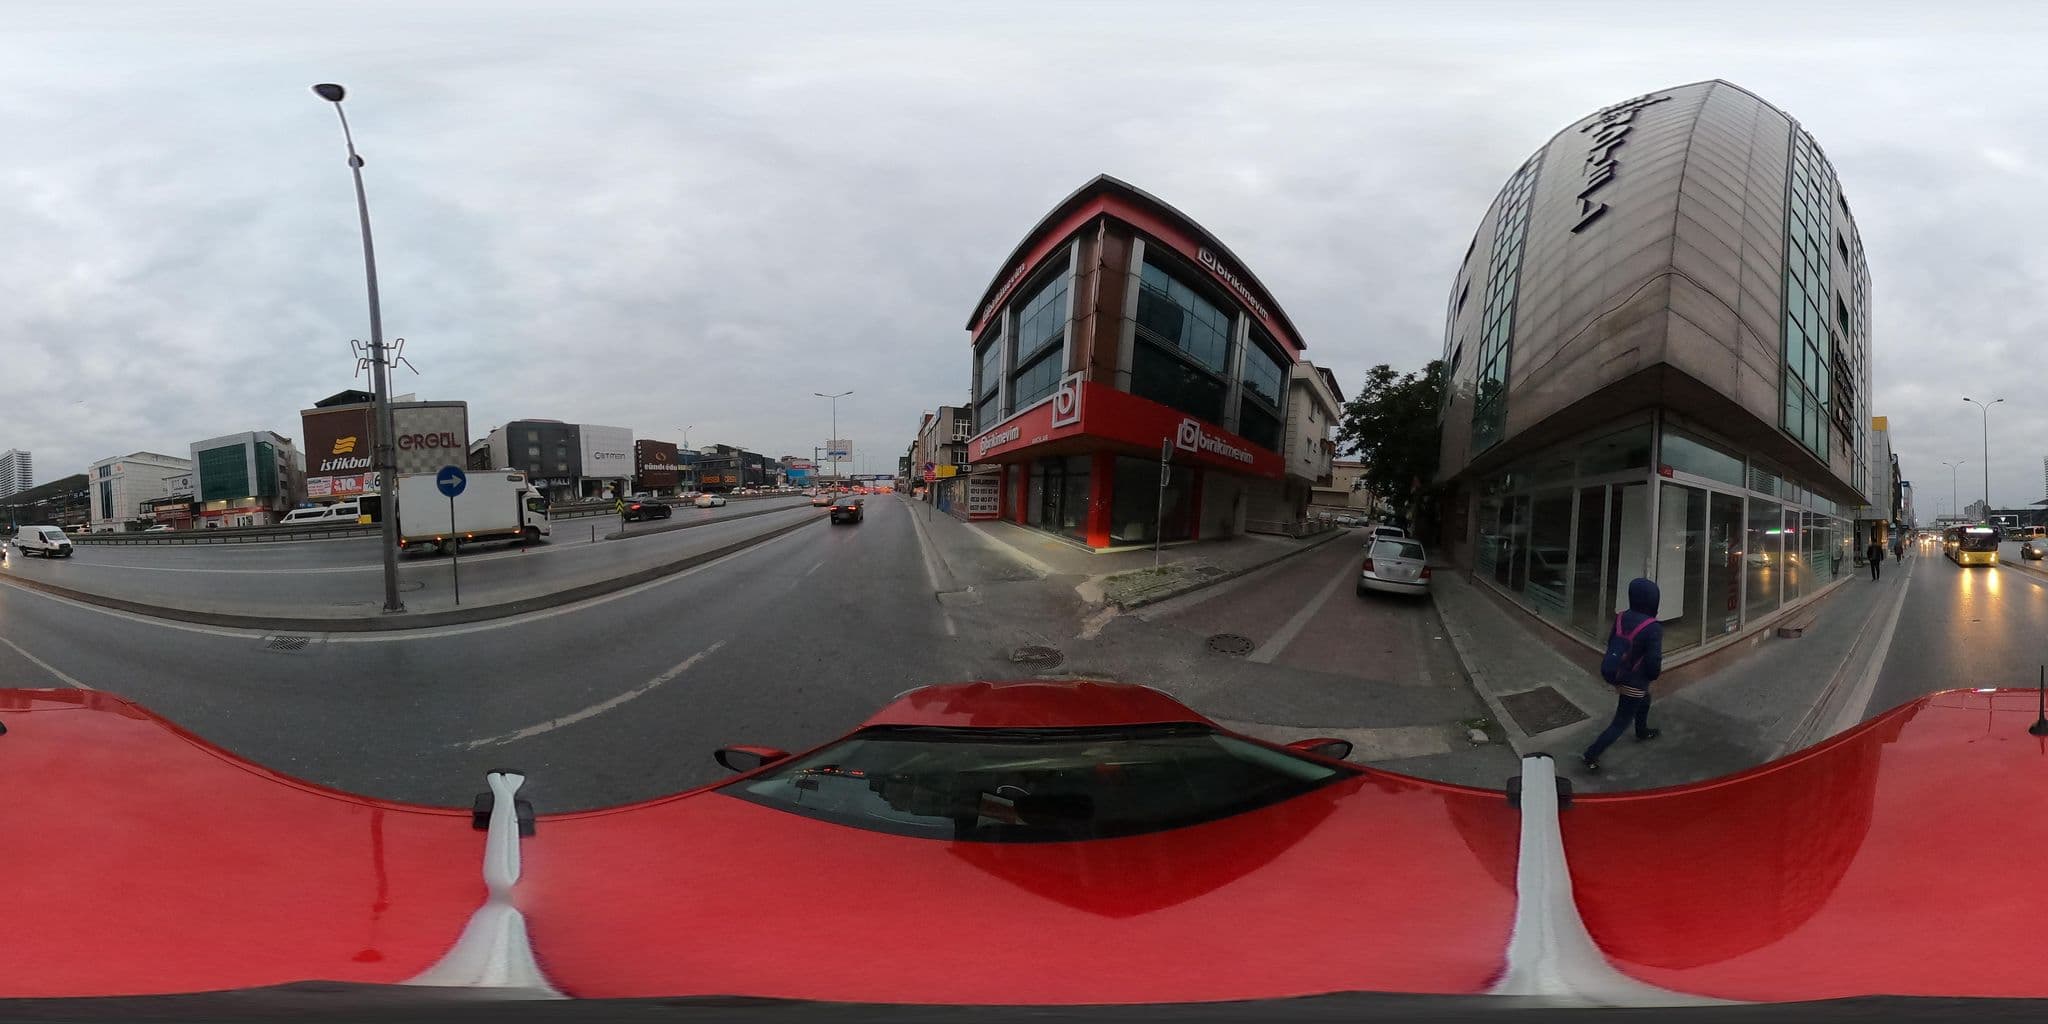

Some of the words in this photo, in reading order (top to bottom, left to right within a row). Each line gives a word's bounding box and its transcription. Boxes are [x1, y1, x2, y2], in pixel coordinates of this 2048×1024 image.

[1216, 263, 1270, 321] birikimevim
[320, 455, 372, 472] istikbal
[1200, 430, 1254, 464] birikimevim
